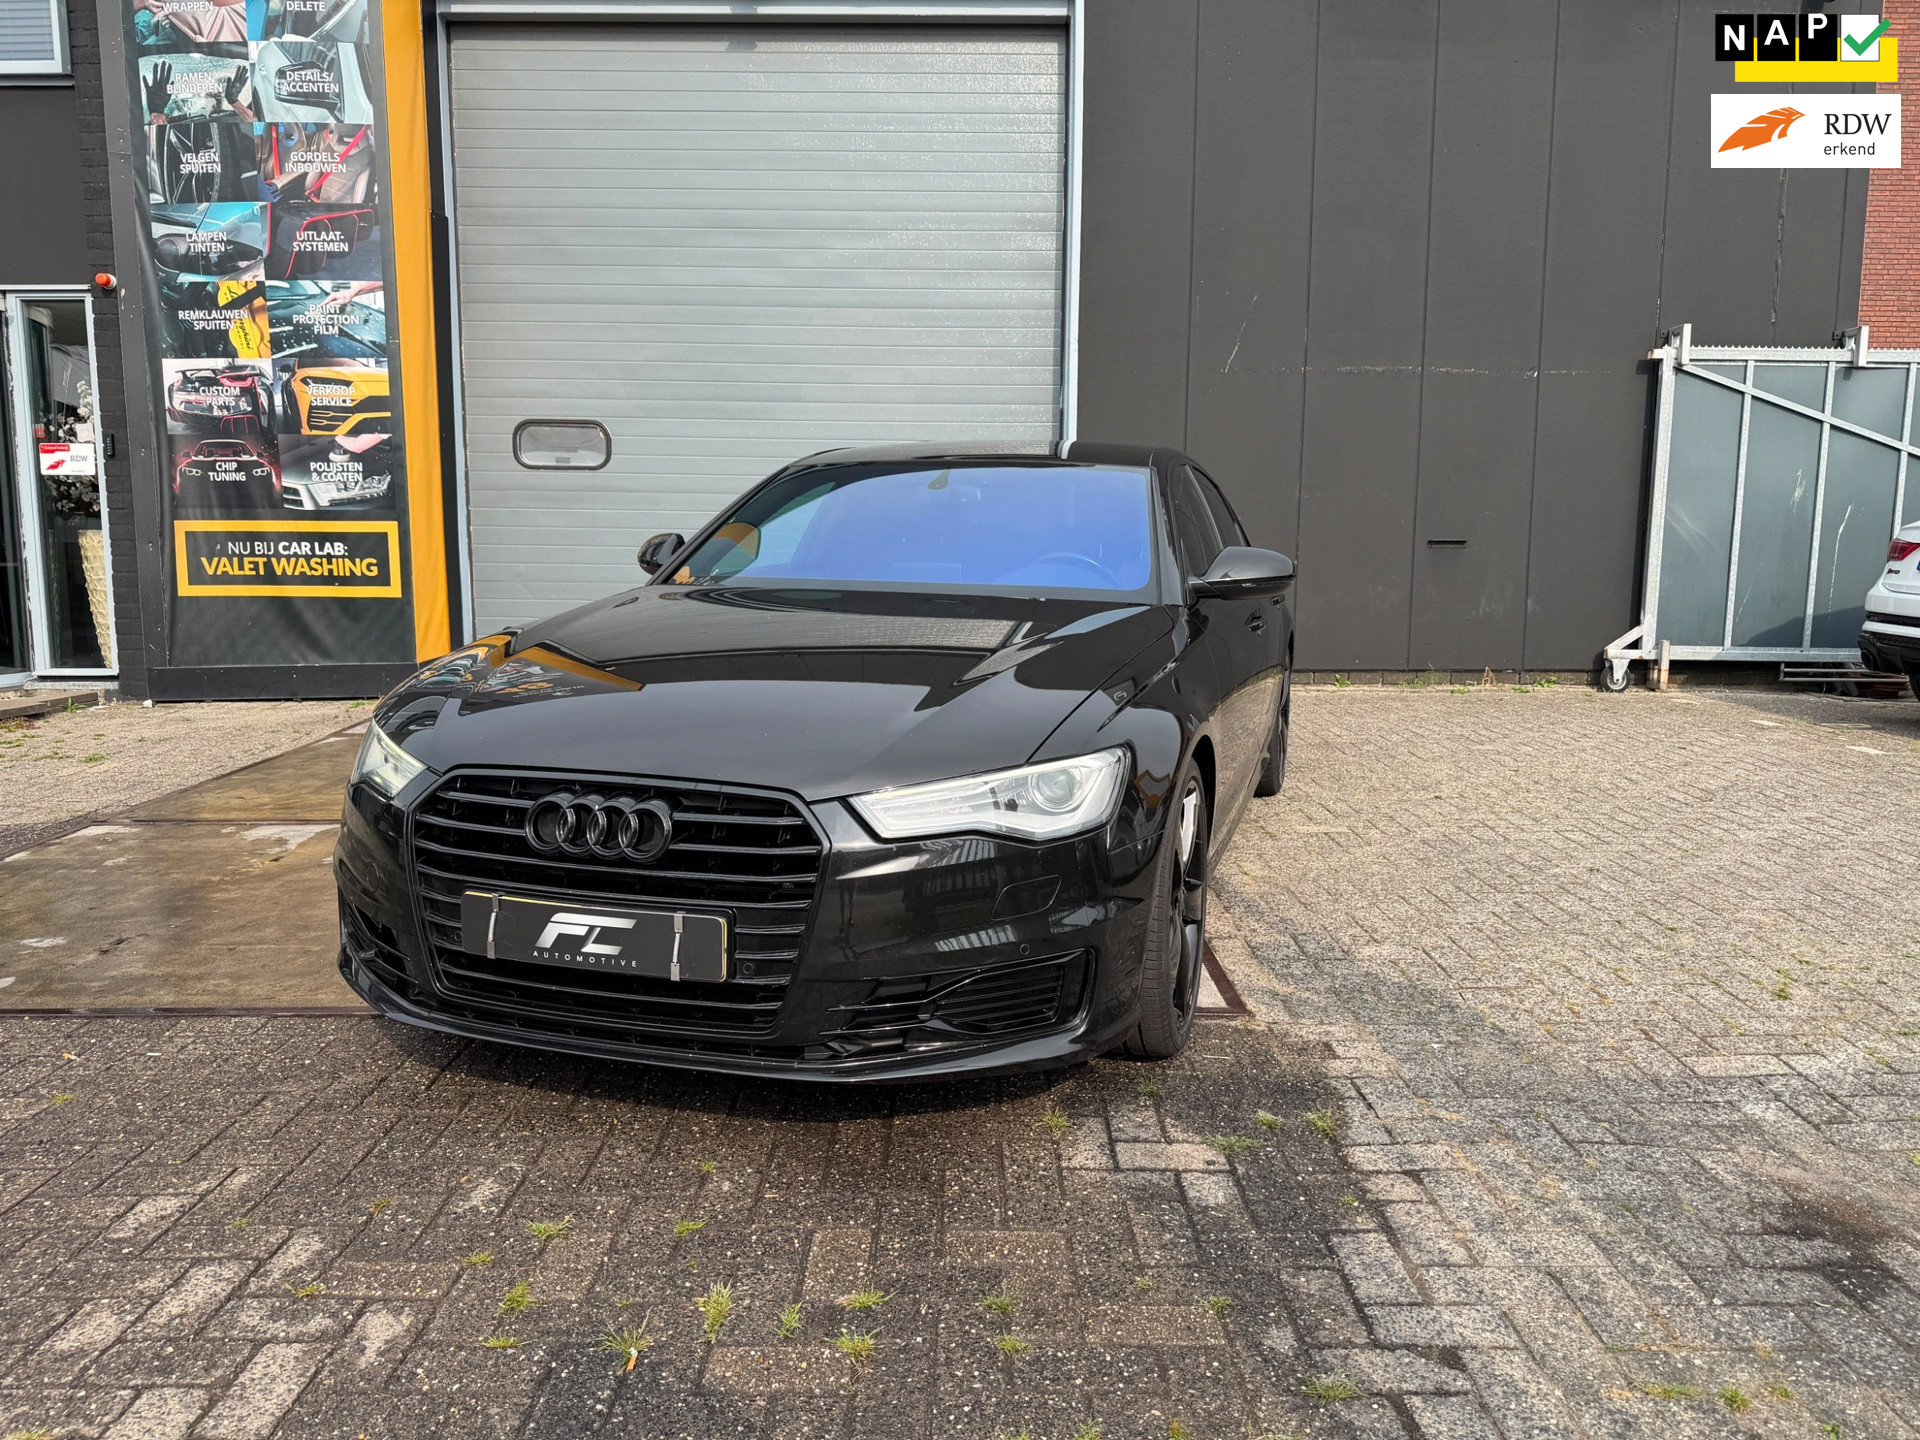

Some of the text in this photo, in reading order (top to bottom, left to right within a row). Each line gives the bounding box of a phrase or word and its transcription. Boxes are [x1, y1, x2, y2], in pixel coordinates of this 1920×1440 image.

[163, 1, 213, 12] WRAPPEN
[286, 1, 326, 12] DELETE
[174, 72, 213, 83] RAMEN
[286, 71, 333, 83] DETAILS/
[166, 83, 223, 94] BLINDEREN
[282, 82, 339, 93] ACCENTEN
[180, 152, 220, 163] VELGEN
[290, 152, 341, 163] GORDELS
[179, 163, 221, 174] SPUITEN
[285, 162, 347, 173] INBOUWEN
[185, 231, 227, 242] LAMPEN
[296, 231, 345, 241] UITLAAT-
[188, 242, 225, 252] TINTEN
[293, 241, 349, 252] SYSTEMEN
[178, 309, 248, 320] REMKLAUWEN
[309, 304, 341, 315] PAINT
[193, 320, 234, 330] SPUITEN
[292, 314, 360, 325] PROTECTION
[313, 324, 339, 335] FILM
[199, 386, 240, 396] CUSTOM
[306, 386, 355, 396] VERKOOP
[206, 396, 236, 407] PARTS
[311, 396, 352, 406] SERVICE
[215, 462, 238, 472] CHIP
[310, 461, 363, 472] POLIJSTEN
[208, 472, 246, 482] TUNING
[311, 472, 363, 482] & COATEN
[228, 542, 349, 556] NU BIJ CAR LAB:
[201, 557, 379, 577] VALET WASHING
[532, 950, 638, 968] AUTOMOTIVE
